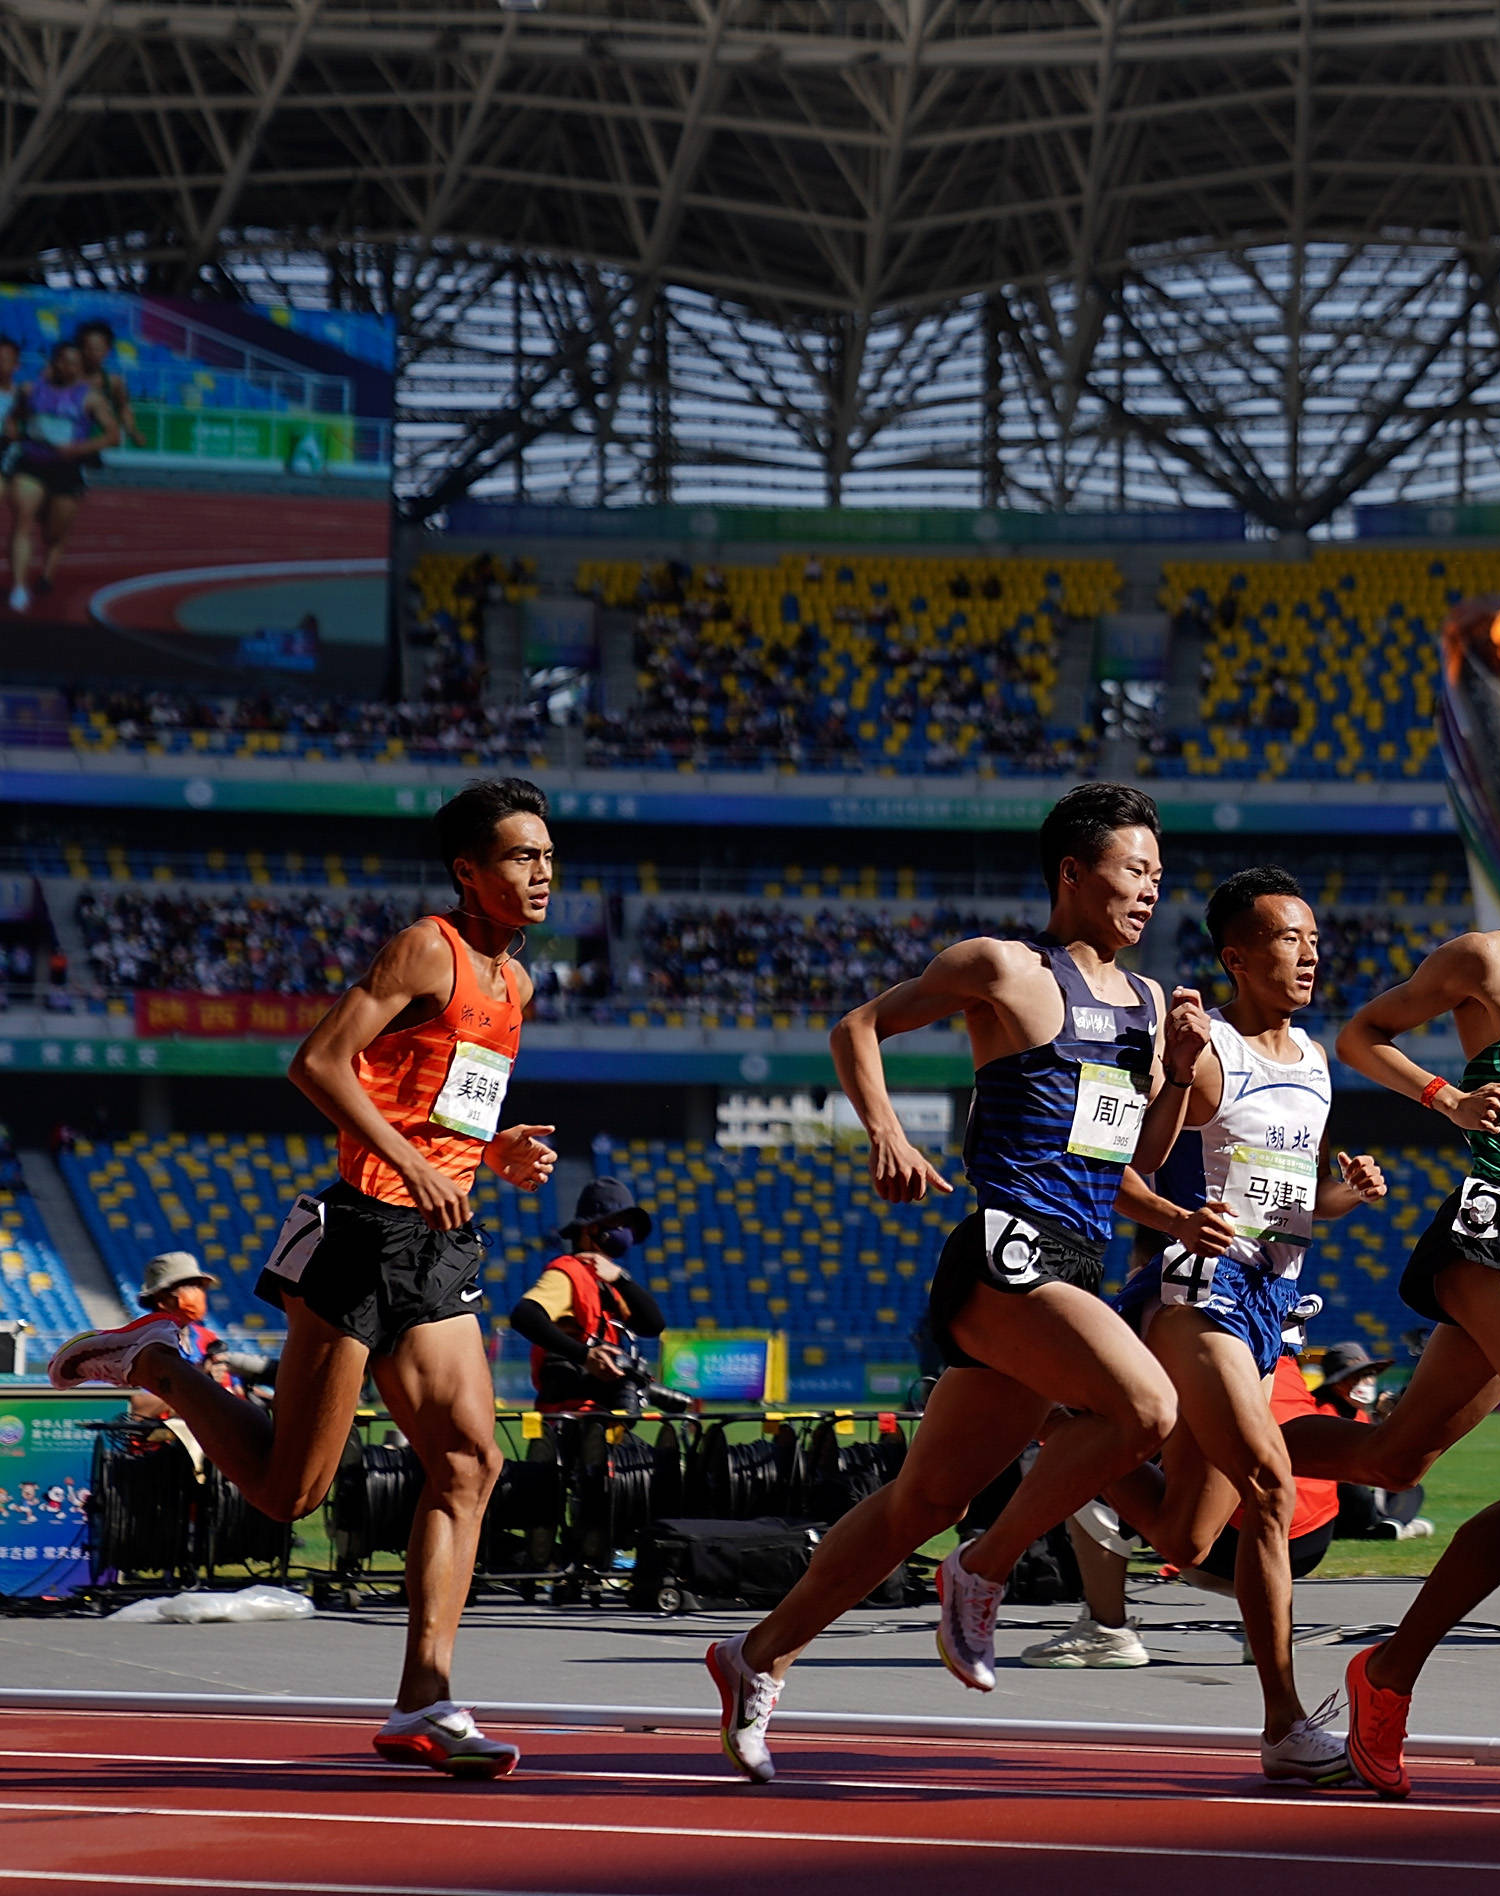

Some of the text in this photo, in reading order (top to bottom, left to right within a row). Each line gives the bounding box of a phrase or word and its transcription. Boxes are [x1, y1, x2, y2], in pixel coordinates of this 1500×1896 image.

[460, 1003, 492, 1029] 浙江
[1265, 1125, 1311, 1150] 湖北
[1244, 1176, 1309, 1214] 马建平
[275, 1198, 322, 1267] 7
[992, 1217, 1038, 1276] 6
[1163, 1250, 1209, 1302] 4
